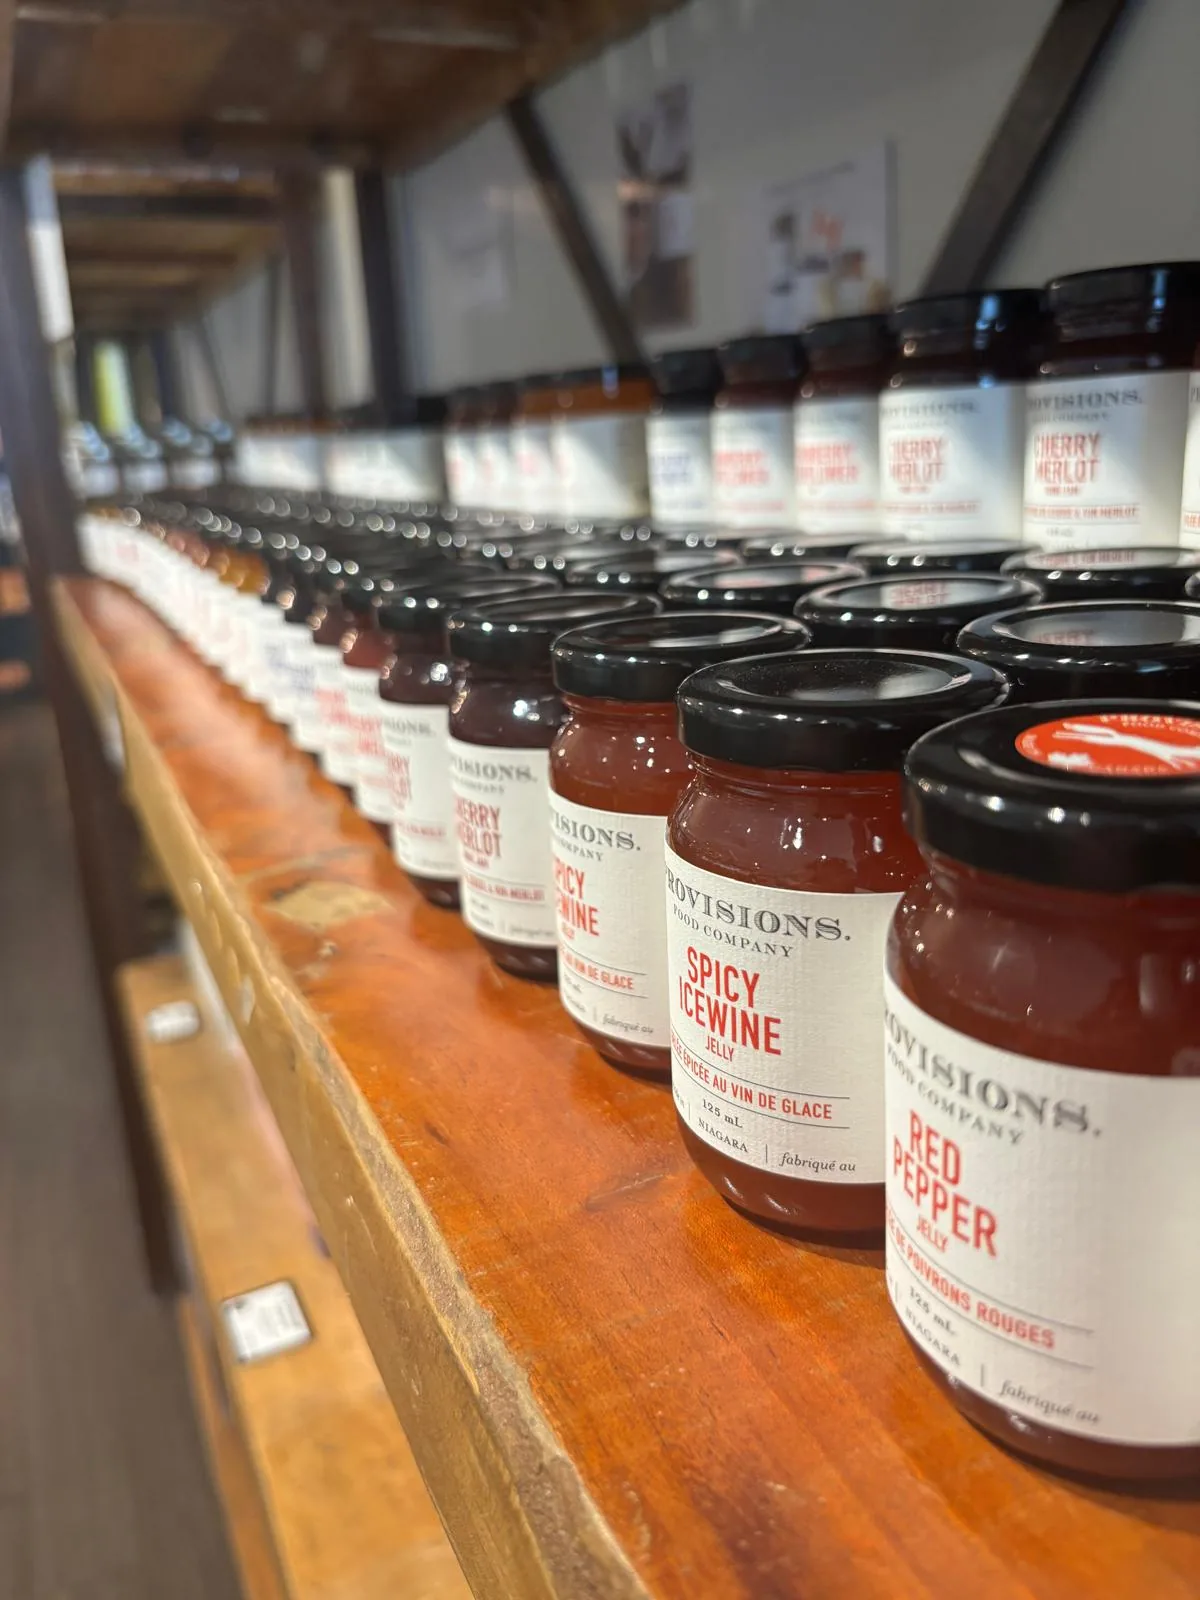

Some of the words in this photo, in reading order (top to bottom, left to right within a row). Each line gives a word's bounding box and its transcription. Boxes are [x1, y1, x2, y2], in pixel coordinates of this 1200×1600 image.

[665, 867, 851, 942] ROVISIONS.
[673, 903, 700, 931] FOOD
[703, 924, 794, 957] COMPANY
[601, 969, 634, 990] GLACE
[687, 945, 760, 1009] SPICY
[679, 975, 782, 1056] ICEWINE
[705, 1035, 735, 1063] JELLY
[885, 1008, 1102, 1137] OVISIONS.
[683, 1048, 710, 1085] ÉPICÉE
[713, 1074, 727, 1093] AU
[731, 1082, 753, 1104] VIN
[758, 1092, 777, 1110] DE
[782, 1098, 832, 1120] GLACE
[702, 1098, 721, 1117] 125
[724, 1114, 743, 1128] mL
[918, 1081, 1023, 1146] COMPANY
[698, 1117, 749, 1153] NIAGARA
[778, 1152, 836, 1172] fabriqué
[838, 1162, 856, 1172] au
[909, 1109, 962, 1187] RED
[893, 1133, 998, 1258] PEPPER
[916, 1214, 949, 1254] JELLY
[907, 1244, 971, 1312] POIVRONS
[976, 1302, 1055, 1349] ROUGES
[908, 1286, 931, 1314] 125
[999, 1378, 1072, 1419] fabriqué
[1074, 1410, 1102, 1424] au
